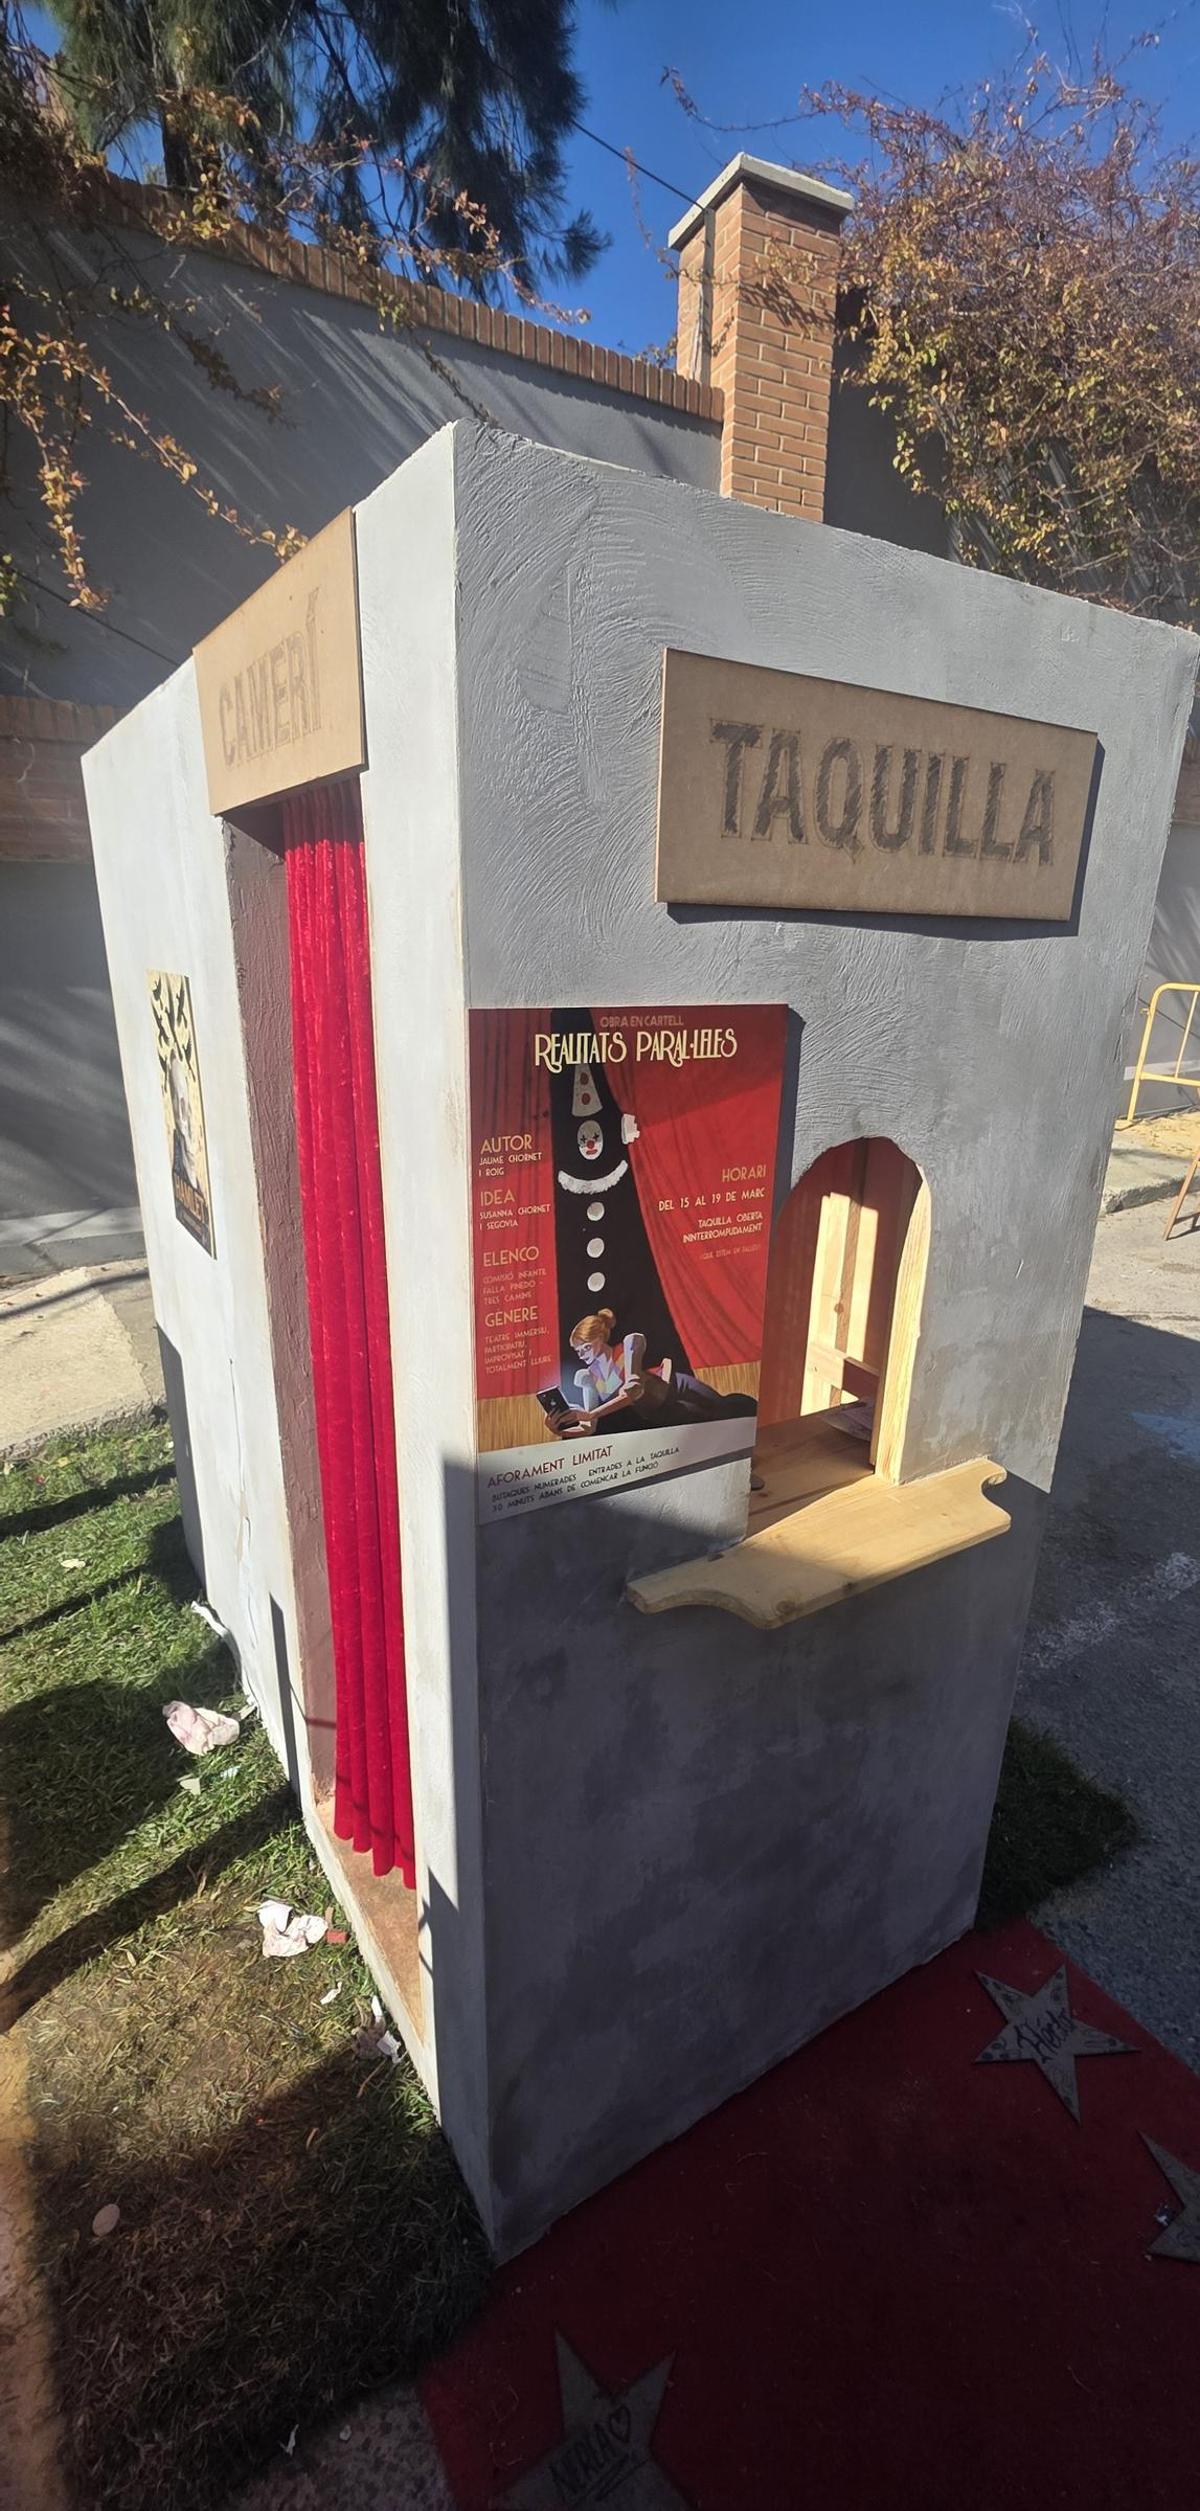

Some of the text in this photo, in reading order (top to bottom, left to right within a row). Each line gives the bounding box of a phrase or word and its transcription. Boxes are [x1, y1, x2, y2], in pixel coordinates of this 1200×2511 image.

[710, 718, 1056, 864] TAQUILLA
[600, 1015, 684, 1028] OBRA EN CARTELL
[535, 1031, 627, 1074] REALITATS
[480, 1133, 533, 1154] AUTOR
[479, 1155, 505, 1166] JAUME
[485, 1167, 505, 1177] ROIG
[722, 1163, 767, 1183] HORARI
[480, 1188, 515, 1207] IDEA
[658, 1199, 675, 1212] DEL
[680, 1197, 690, 1209] 15
[694, 1195, 708, 1208] AL
[711, 1193, 722, 1205] 19
[725, 1191, 737, 1203] DE
[479, 1209, 513, 1220] SUSANNA
[698, 1210, 764, 1228] TAQUILLA OBERTA
[486, 1219, 519, 1231] SEGOVIA
[483, 1245, 539, 1267] ELENCO
[487, 1445, 613, 1488] AFORAMENT LIMITAT
[492, 1447, 680, 1503] BUTAQUES NUMERADES ENTRADES A LA TAQUILLA
[507, 1495, 535, 1509] MINUTS
[540, 1488, 563, 1500] ABANS
[567, 1483, 576, 1493] DE
[622, 1470, 632, 1478] LA
